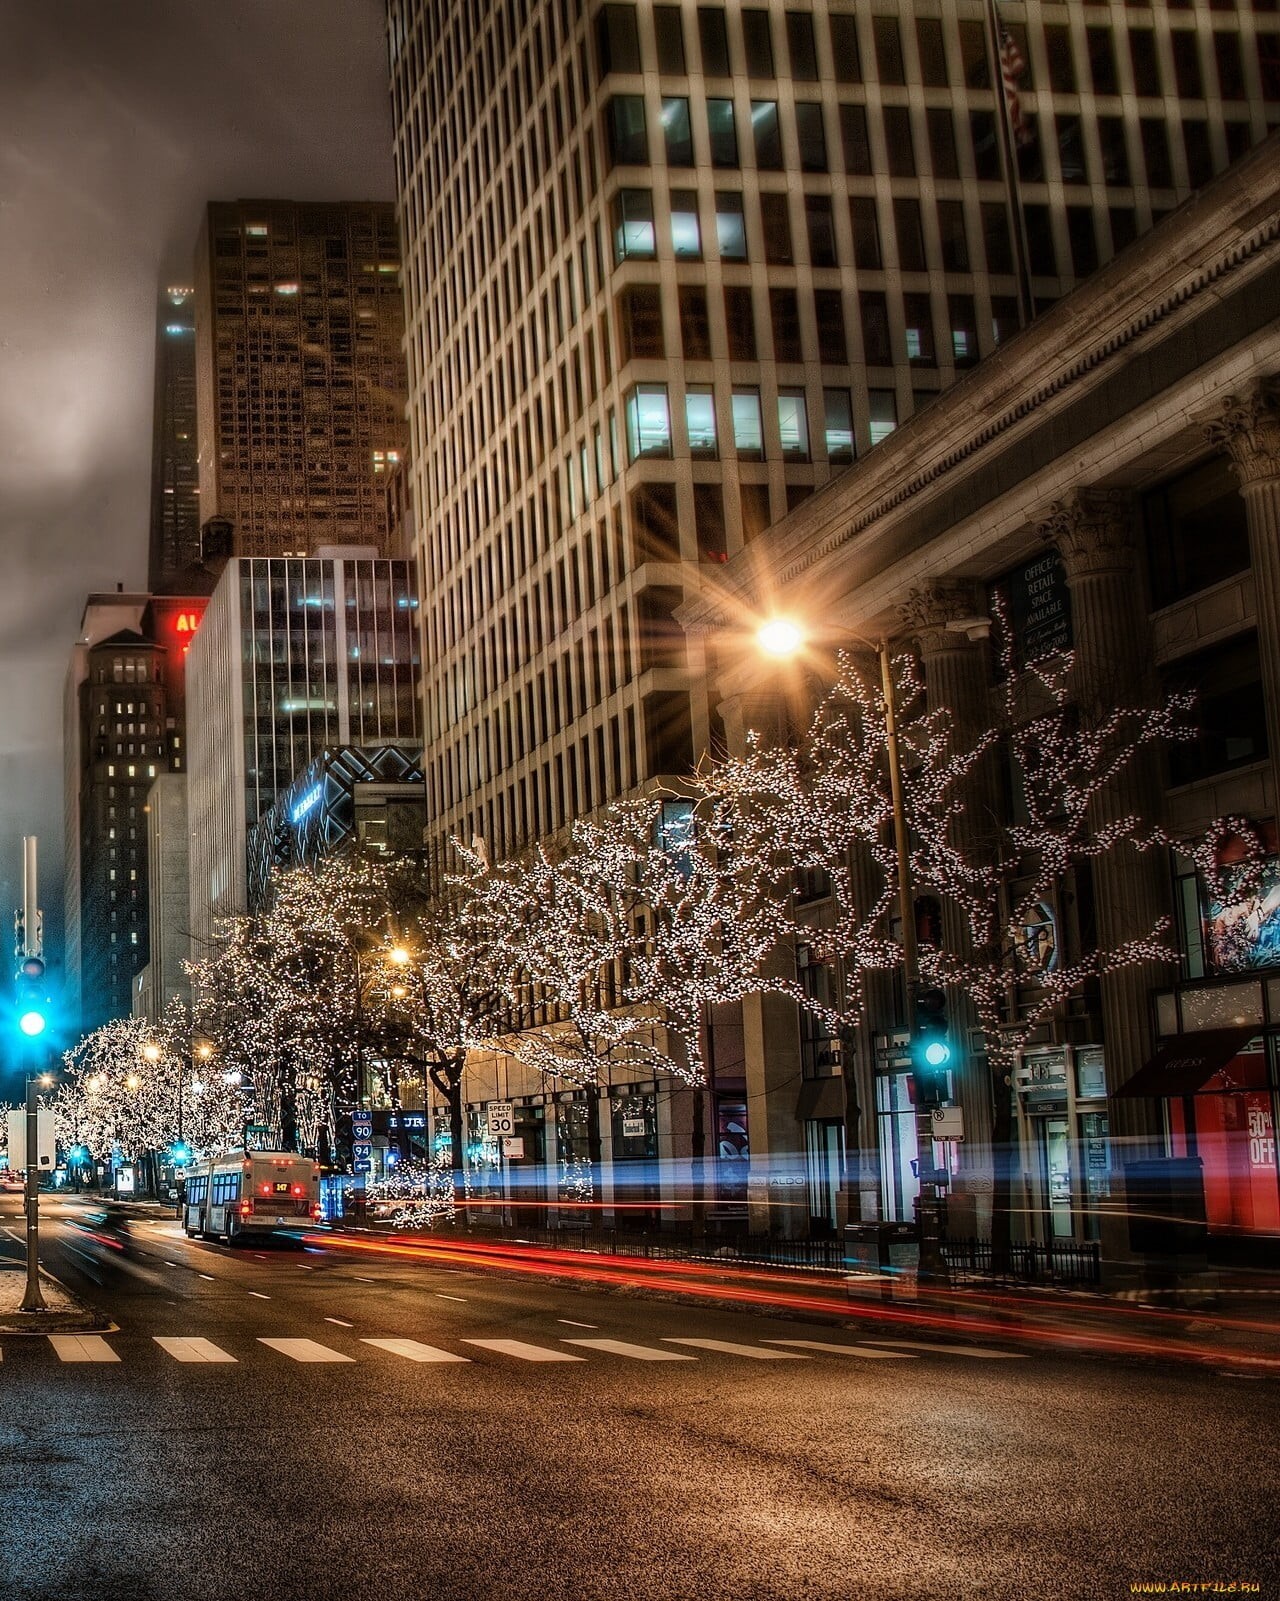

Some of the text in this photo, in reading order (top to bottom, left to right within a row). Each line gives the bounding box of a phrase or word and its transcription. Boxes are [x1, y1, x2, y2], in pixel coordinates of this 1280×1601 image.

[1028, 573, 1056, 596] RETAIL
[1031, 589, 1053, 609] SPACE
[1027, 599, 1063, 626] AVAILABLE
[355, 1126, 370, 1137] 90
[491, 1119, 511, 1132] 30
[1248, 1112, 1273, 1138] 50%
[355, 1146, 369, 1156] 94
[1250, 1138, 1275, 1164] OFF
[771, 1177, 804, 1185] ALDO
